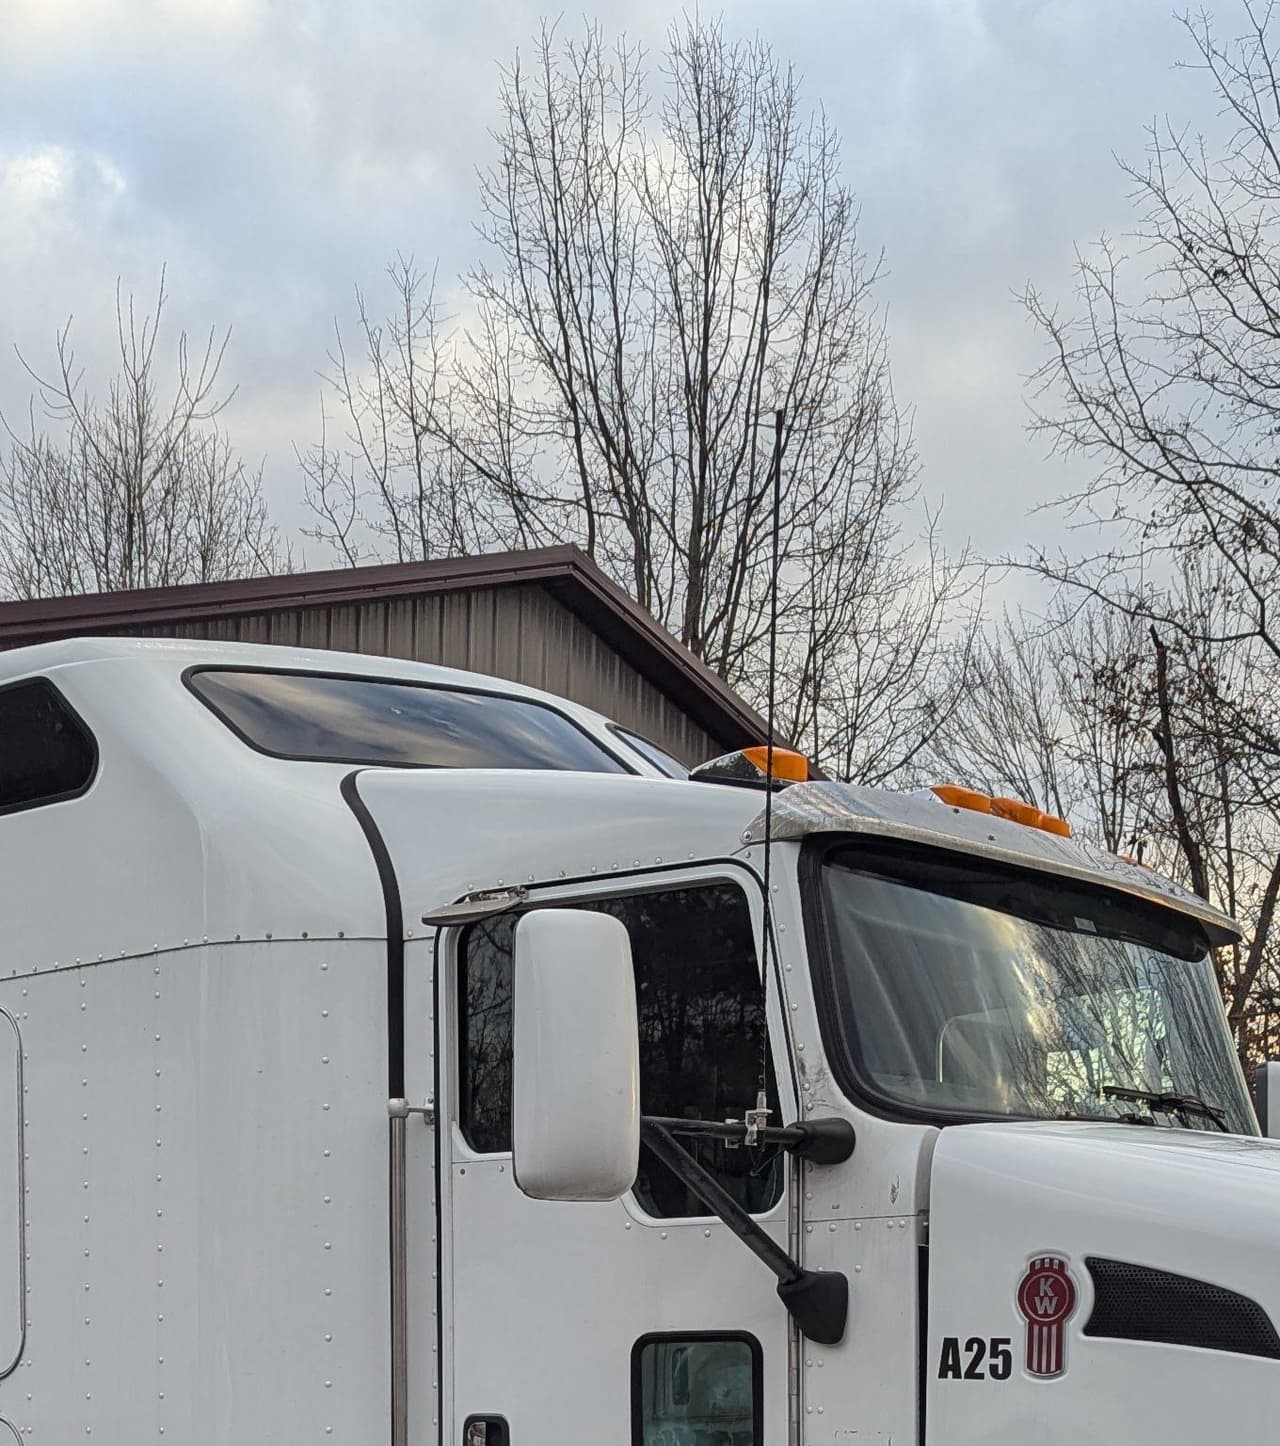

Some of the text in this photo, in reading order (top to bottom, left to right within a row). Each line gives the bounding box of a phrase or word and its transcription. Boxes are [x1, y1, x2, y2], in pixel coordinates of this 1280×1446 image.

[1038, 1277, 1055, 1297] K
[1034, 1296, 1058, 1315] W
[937, 1337, 1013, 1381] A25
